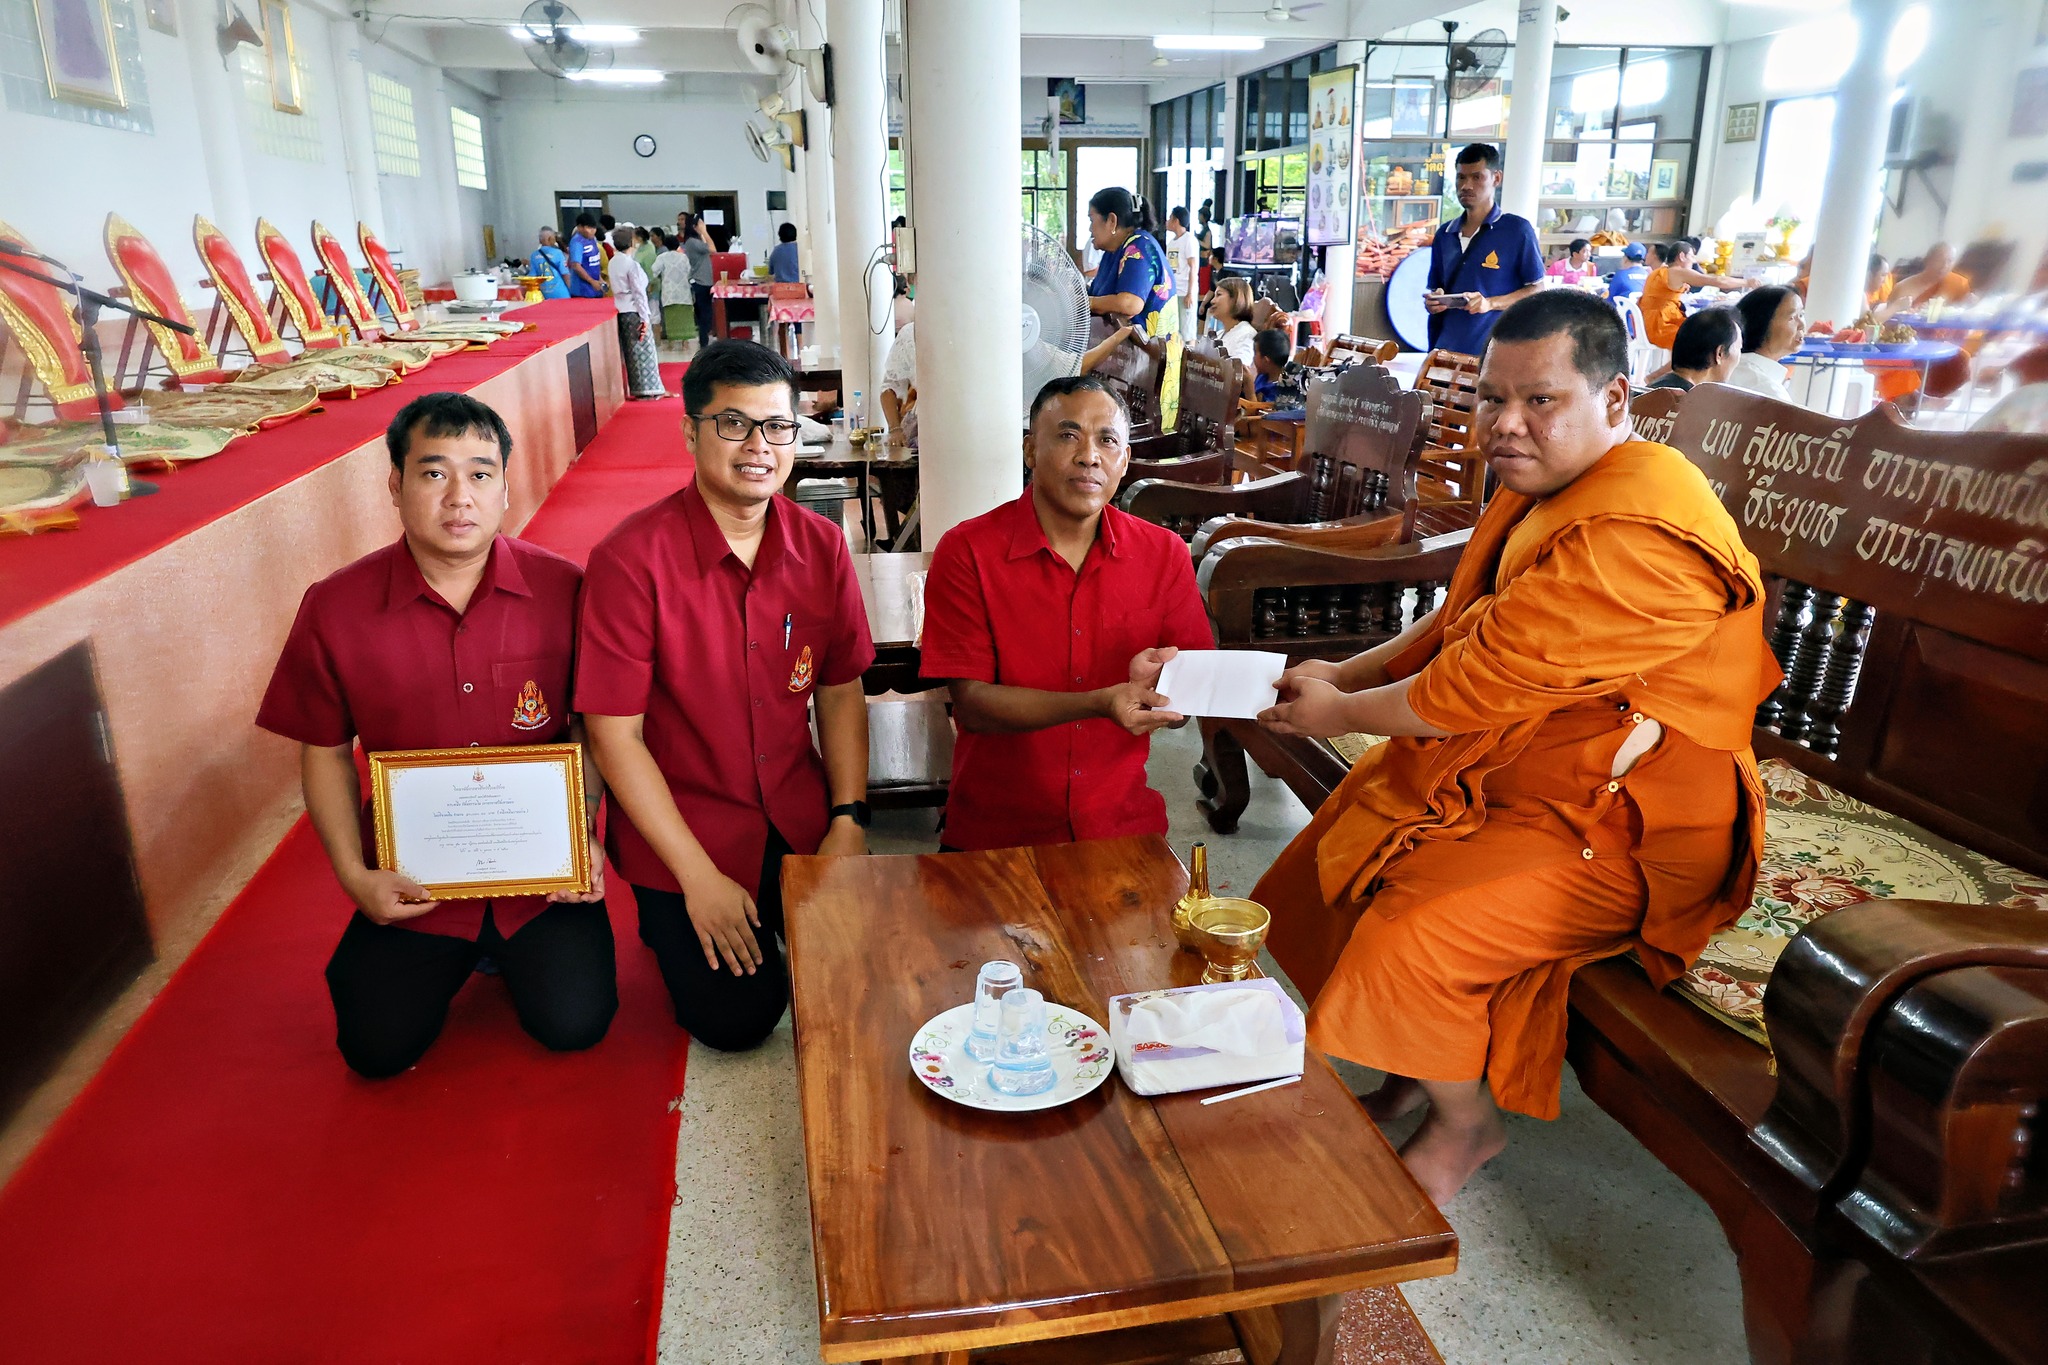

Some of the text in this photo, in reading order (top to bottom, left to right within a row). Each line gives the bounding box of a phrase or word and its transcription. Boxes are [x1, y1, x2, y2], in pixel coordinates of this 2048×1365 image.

[1743, 422, 1858, 482] สุพรรณี
[1743, 473, 1849, 552] ธีระยุทธ
